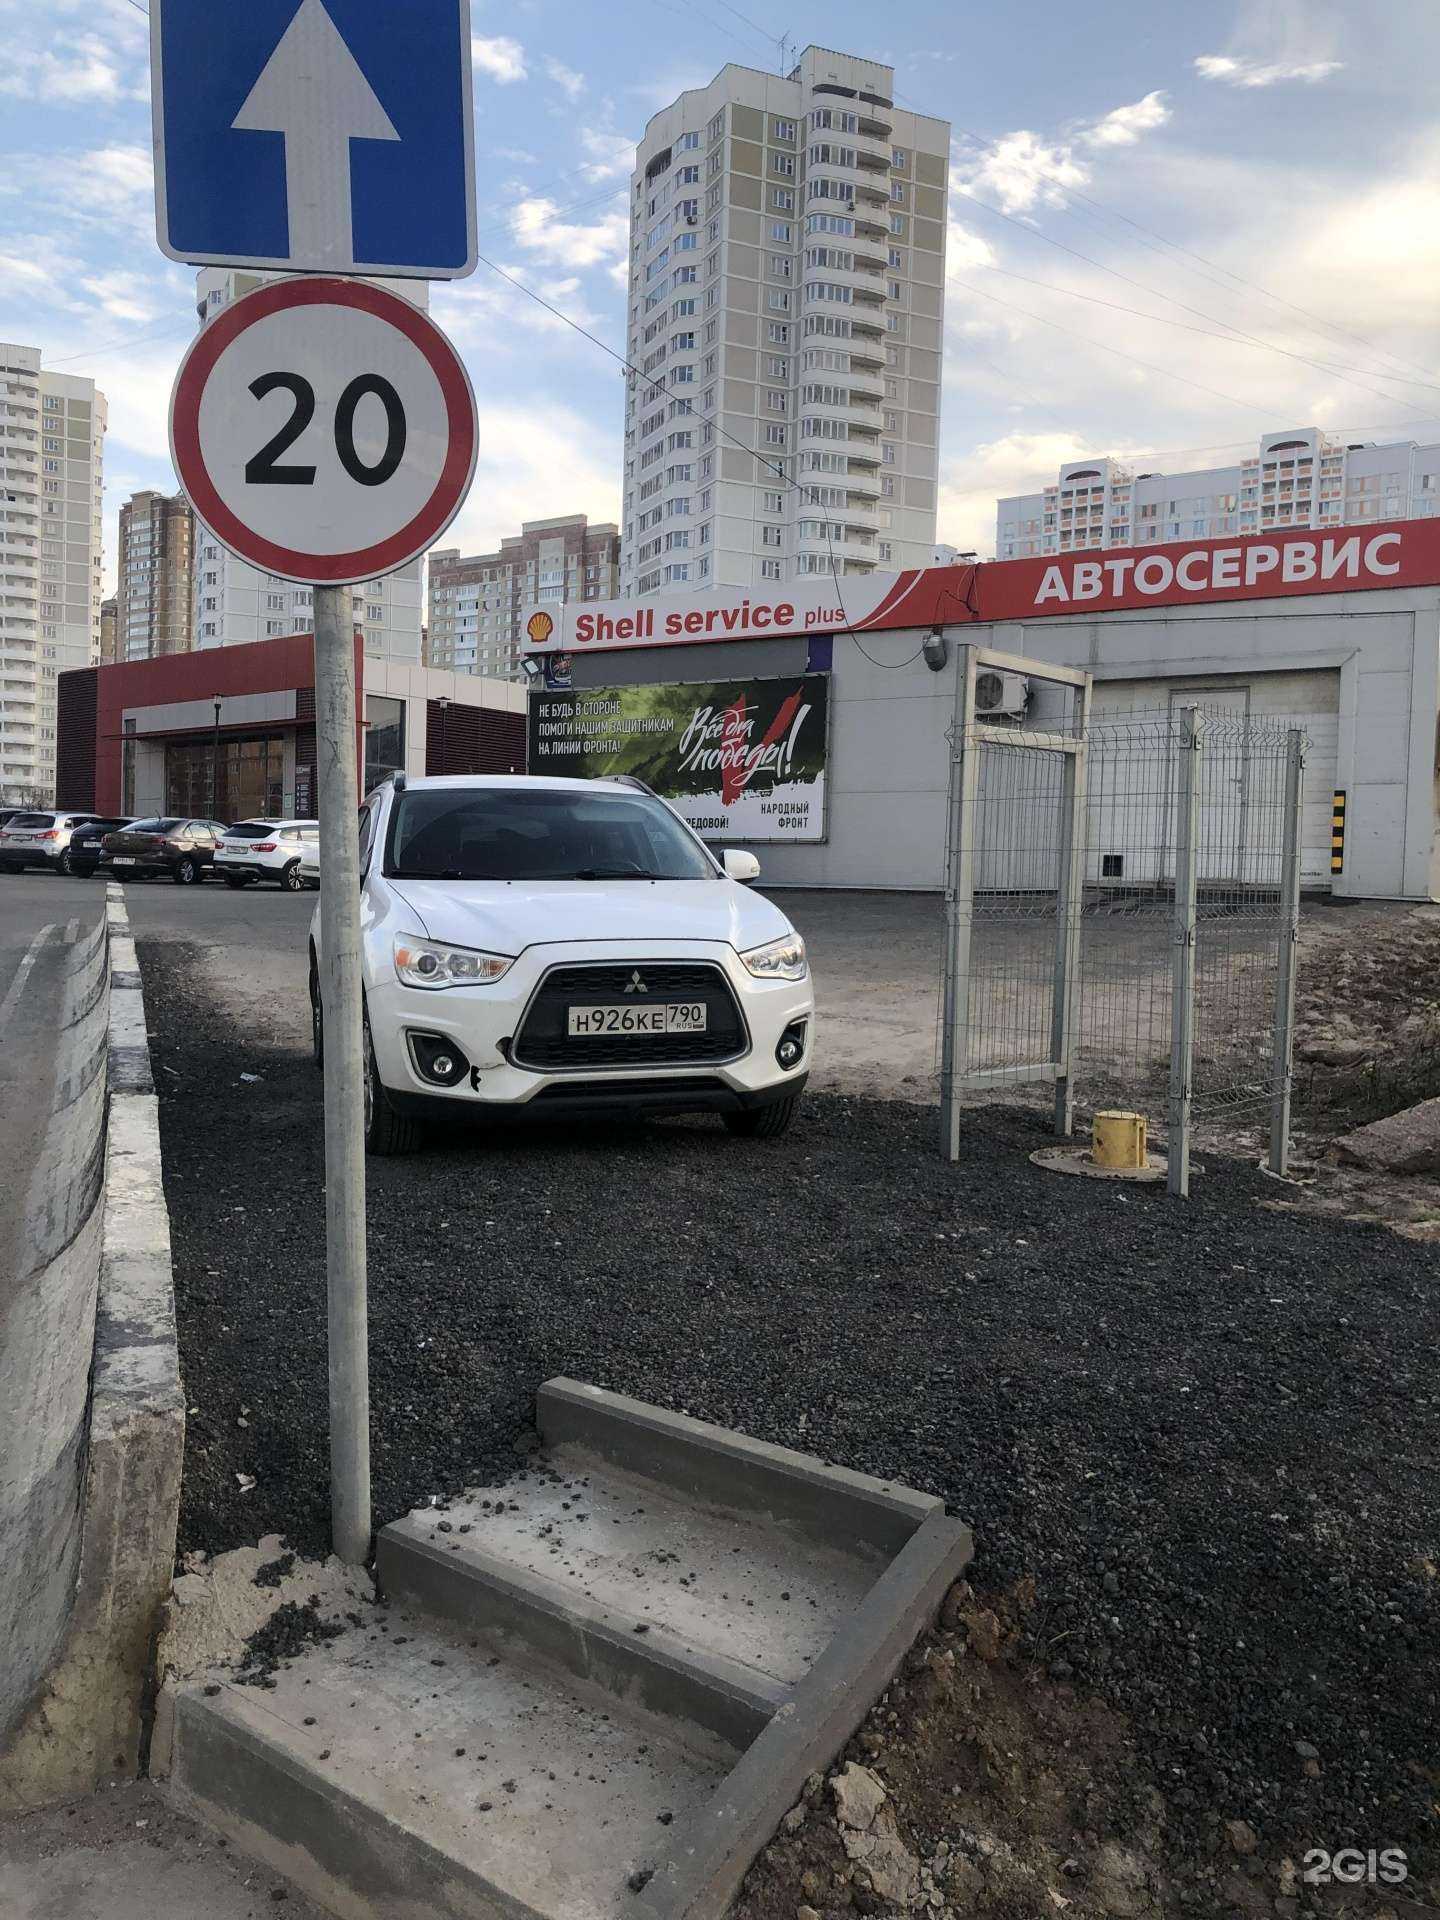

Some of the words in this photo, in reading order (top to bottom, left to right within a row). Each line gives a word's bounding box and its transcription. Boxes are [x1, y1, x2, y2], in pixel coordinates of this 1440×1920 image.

[245, 371, 407, 486] 20
[1034, 533, 1402, 604] АВТОСЕРВИС
[575, 609, 654, 642] Shell
[665, 600, 795, 634] service
[804, 605, 845, 628] plus
[539, 704, 550, 717] НЕ
[551, 703, 574, 718] БУДЬ
[575, 702, 581, 716] В
[538, 722, 573, 737] ПОМОГИ
[575, 720, 608, 735] НАШИМ
[611, 718, 674, 734] ЗАЩИТНИКАМ
[538, 742, 550, 755] НА
[551, 741, 581, 755] ЛИНИИ
[583, 739, 621, 754] ФРОНТА!
[760, 802, 809, 815] НАРОДНЫЙ
[683, 815, 729, 830] РЕДОВОЙ!
[778, 817, 809, 829] ФРОНТ
[576, 1009, 664, 1032] Н926КЕ
[669, 1006, 701, 1023] 790
